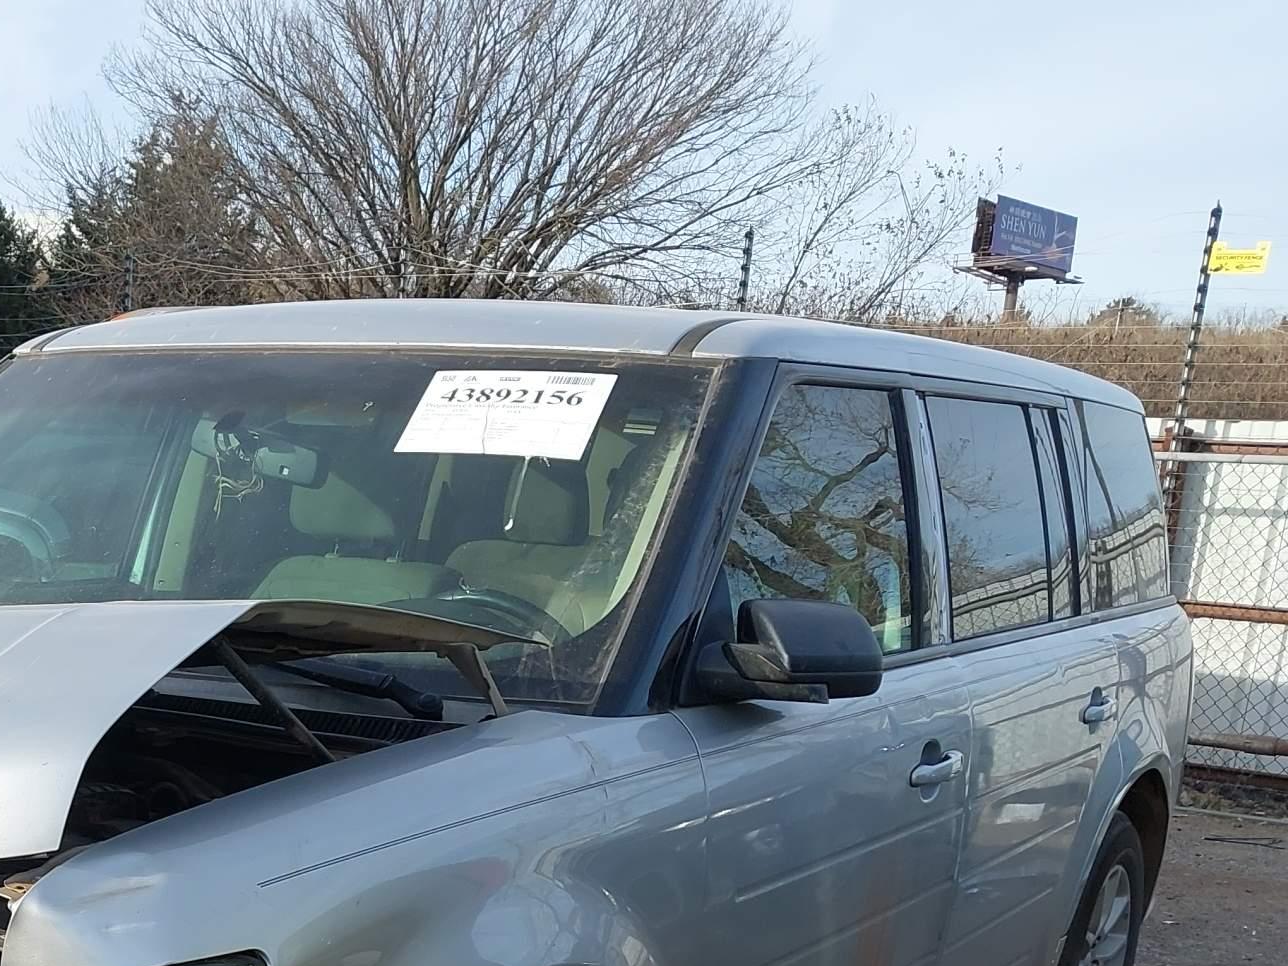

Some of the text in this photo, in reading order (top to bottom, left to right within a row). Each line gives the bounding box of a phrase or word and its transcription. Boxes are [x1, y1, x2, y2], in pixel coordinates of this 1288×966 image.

[1000, 214, 1047, 240] SHEN YUN
[440, 387, 587, 406] 43892156
